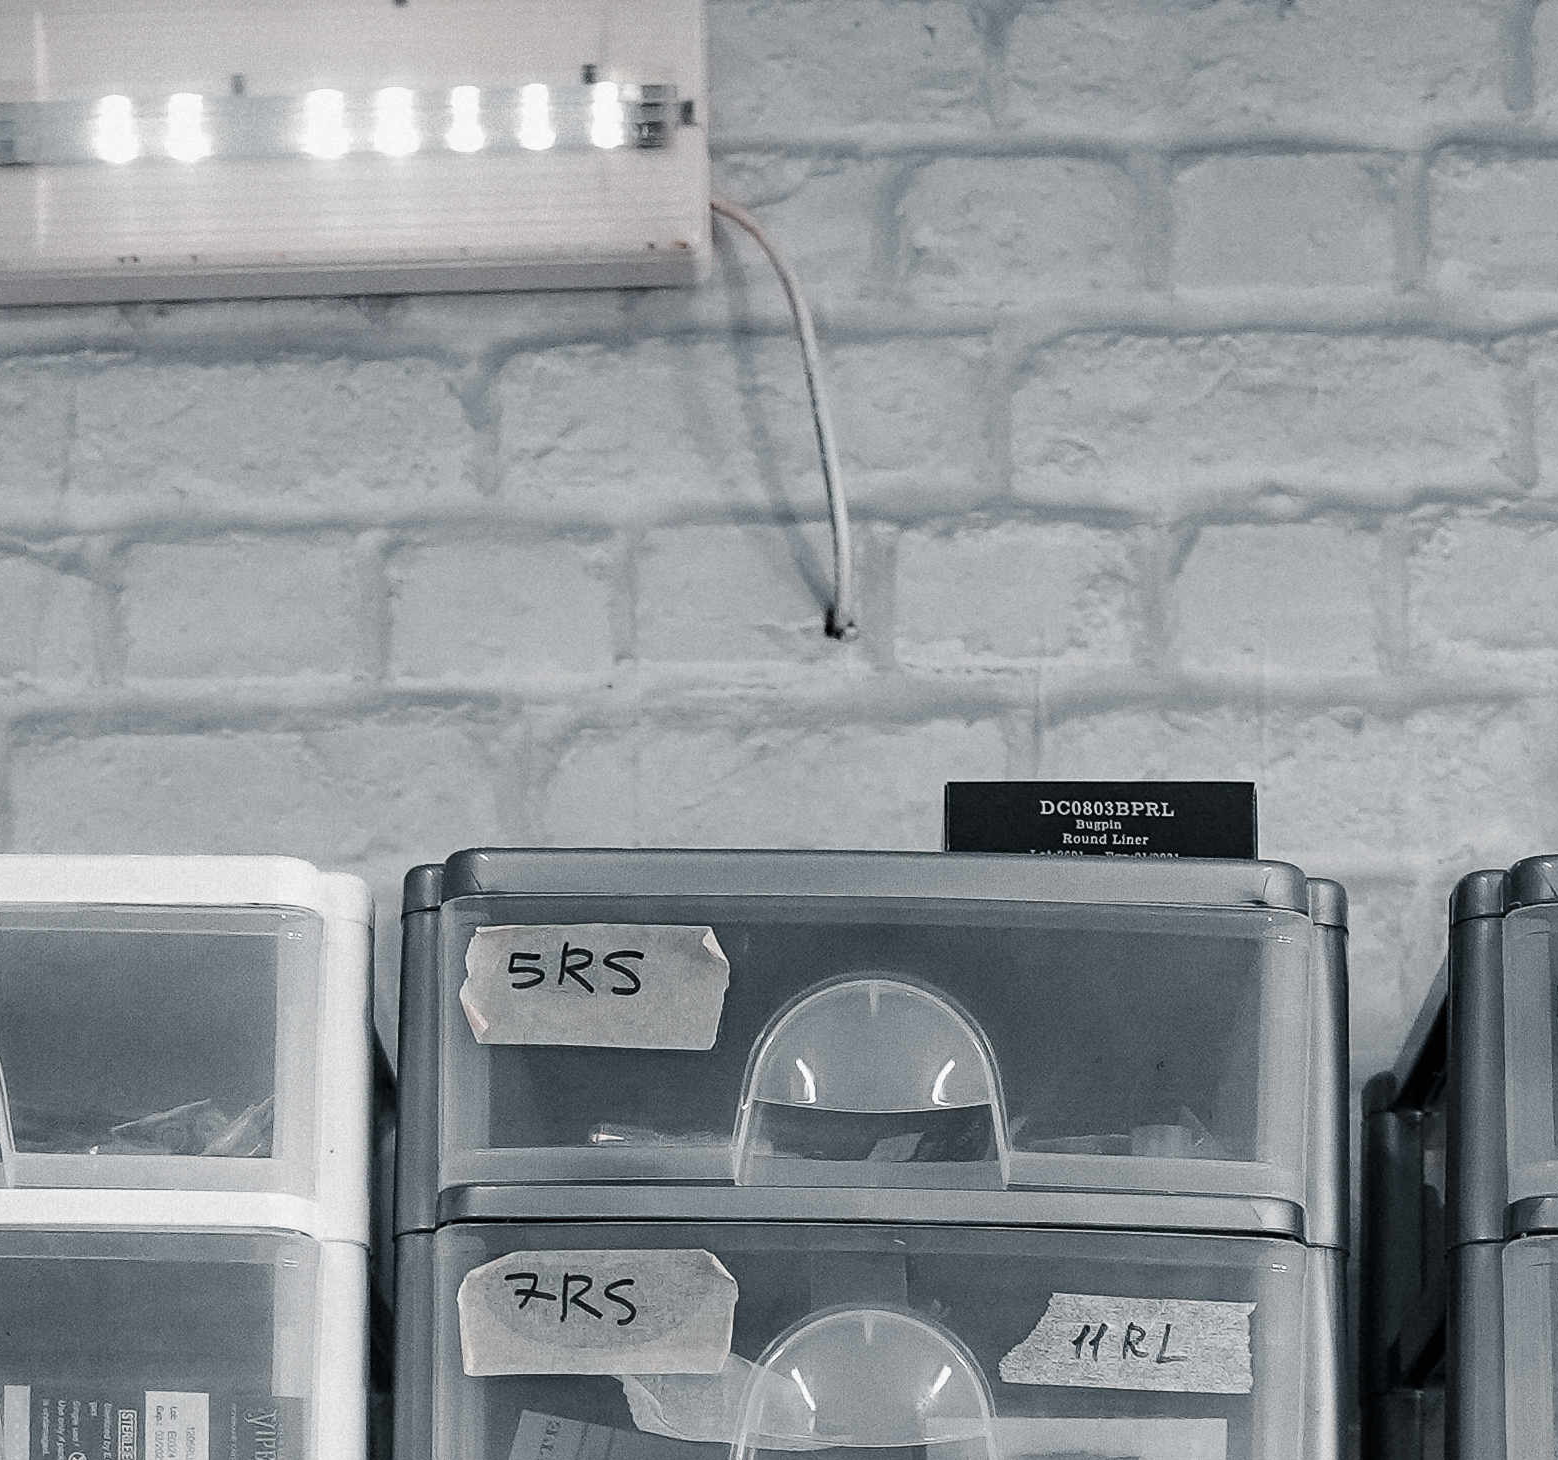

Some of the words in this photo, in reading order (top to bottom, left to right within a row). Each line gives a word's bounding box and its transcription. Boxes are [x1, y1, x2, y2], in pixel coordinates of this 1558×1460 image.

[1040, 801, 1174, 816] DC0803BPRL
[1076, 819, 1121, 831] Bugpin
[1063, 833, 1107, 844] Round
[1113, 834, 1149, 845] Liner
[505, 941, 645, 996] 5RS
[505, 1270, 640, 1327] 7RS
